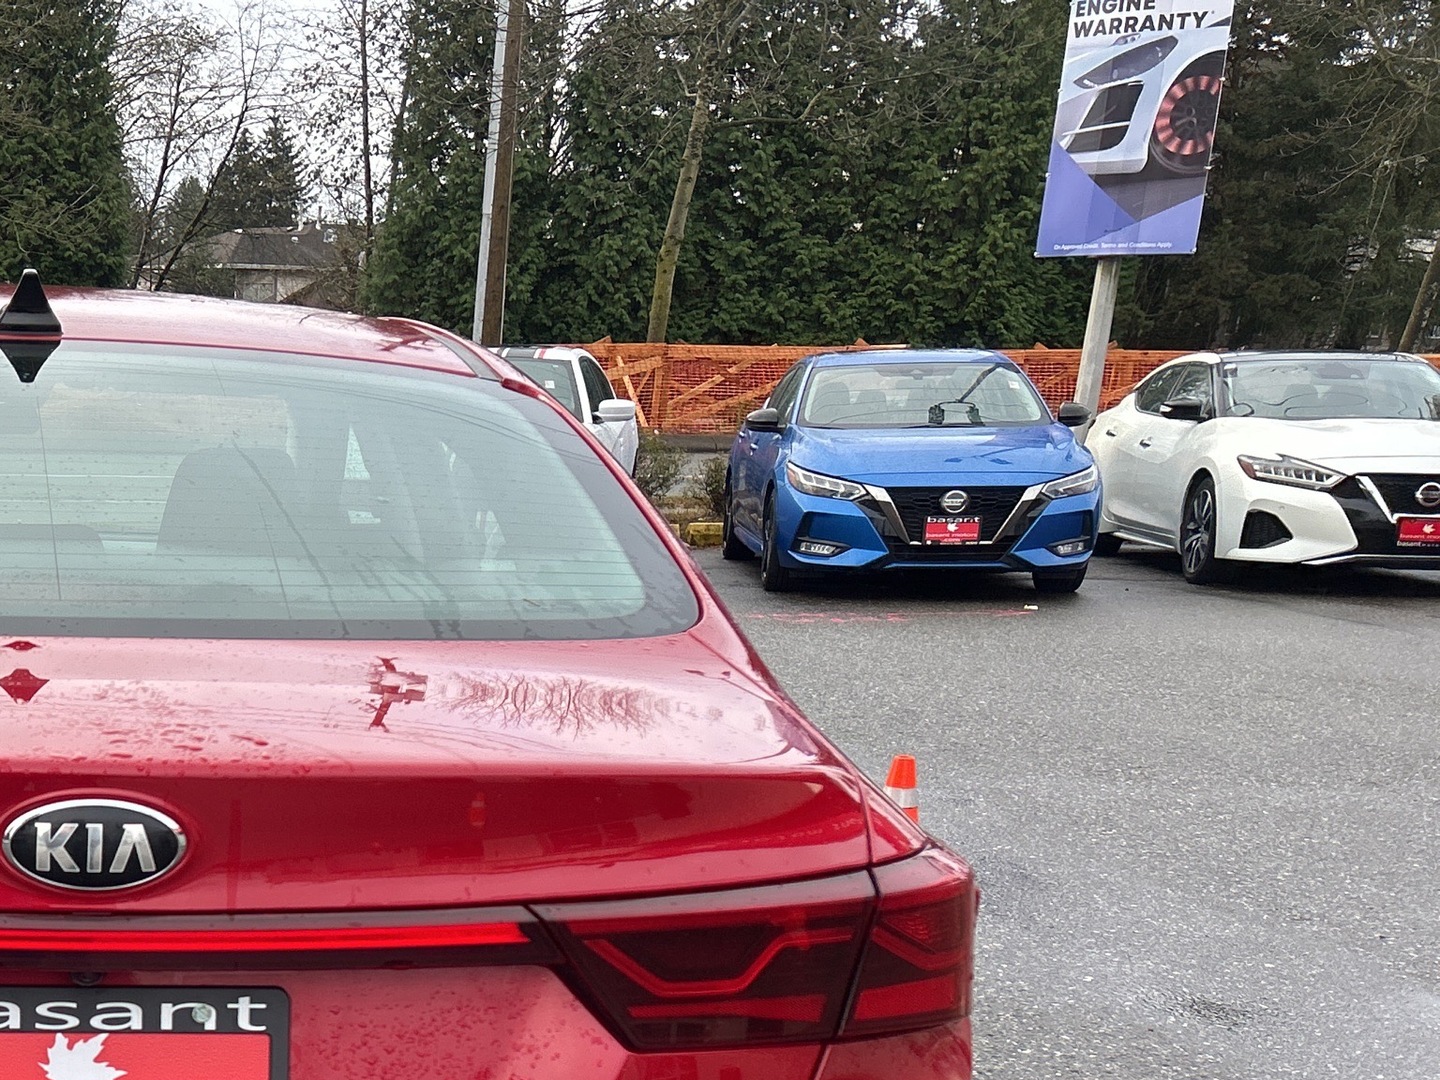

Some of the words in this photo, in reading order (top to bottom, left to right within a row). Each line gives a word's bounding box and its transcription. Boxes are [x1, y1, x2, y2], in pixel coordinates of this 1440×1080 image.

[1075, 0, 1156, 17] ENGINE
[1073, 11, 1208, 38] WARRANTY
[34, 821, 157, 874] KIA
